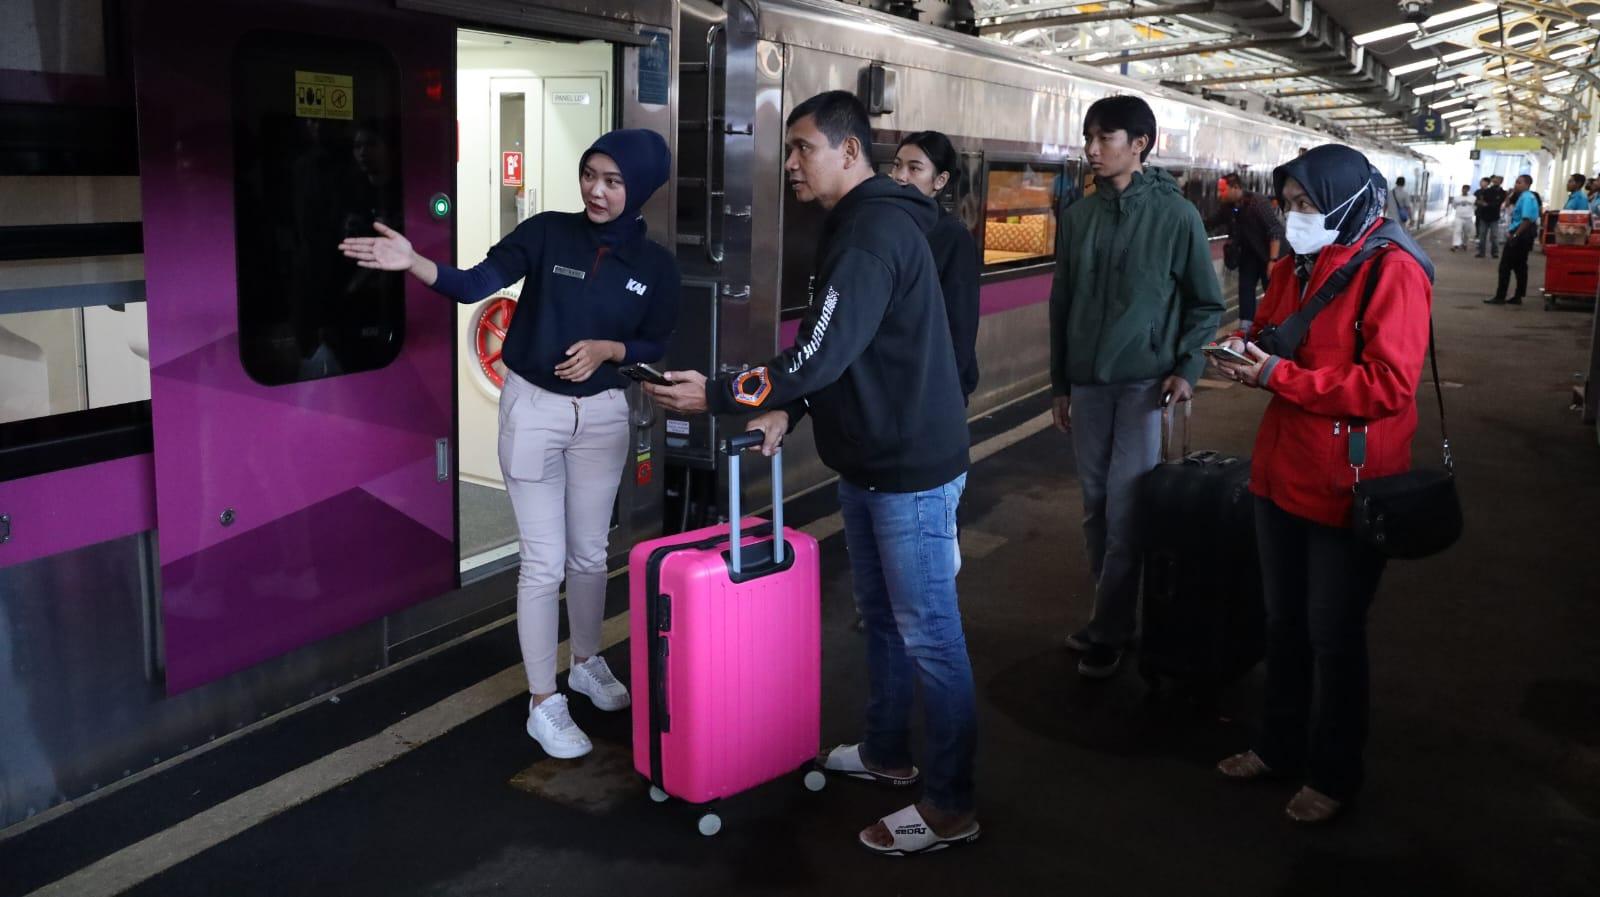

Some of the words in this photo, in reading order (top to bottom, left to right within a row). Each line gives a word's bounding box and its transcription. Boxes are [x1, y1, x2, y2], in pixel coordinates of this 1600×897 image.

[1424, 119, 1436, 132] 3
[625, 278, 647, 296] KAI
[803, 304, 833, 360] BREAK
